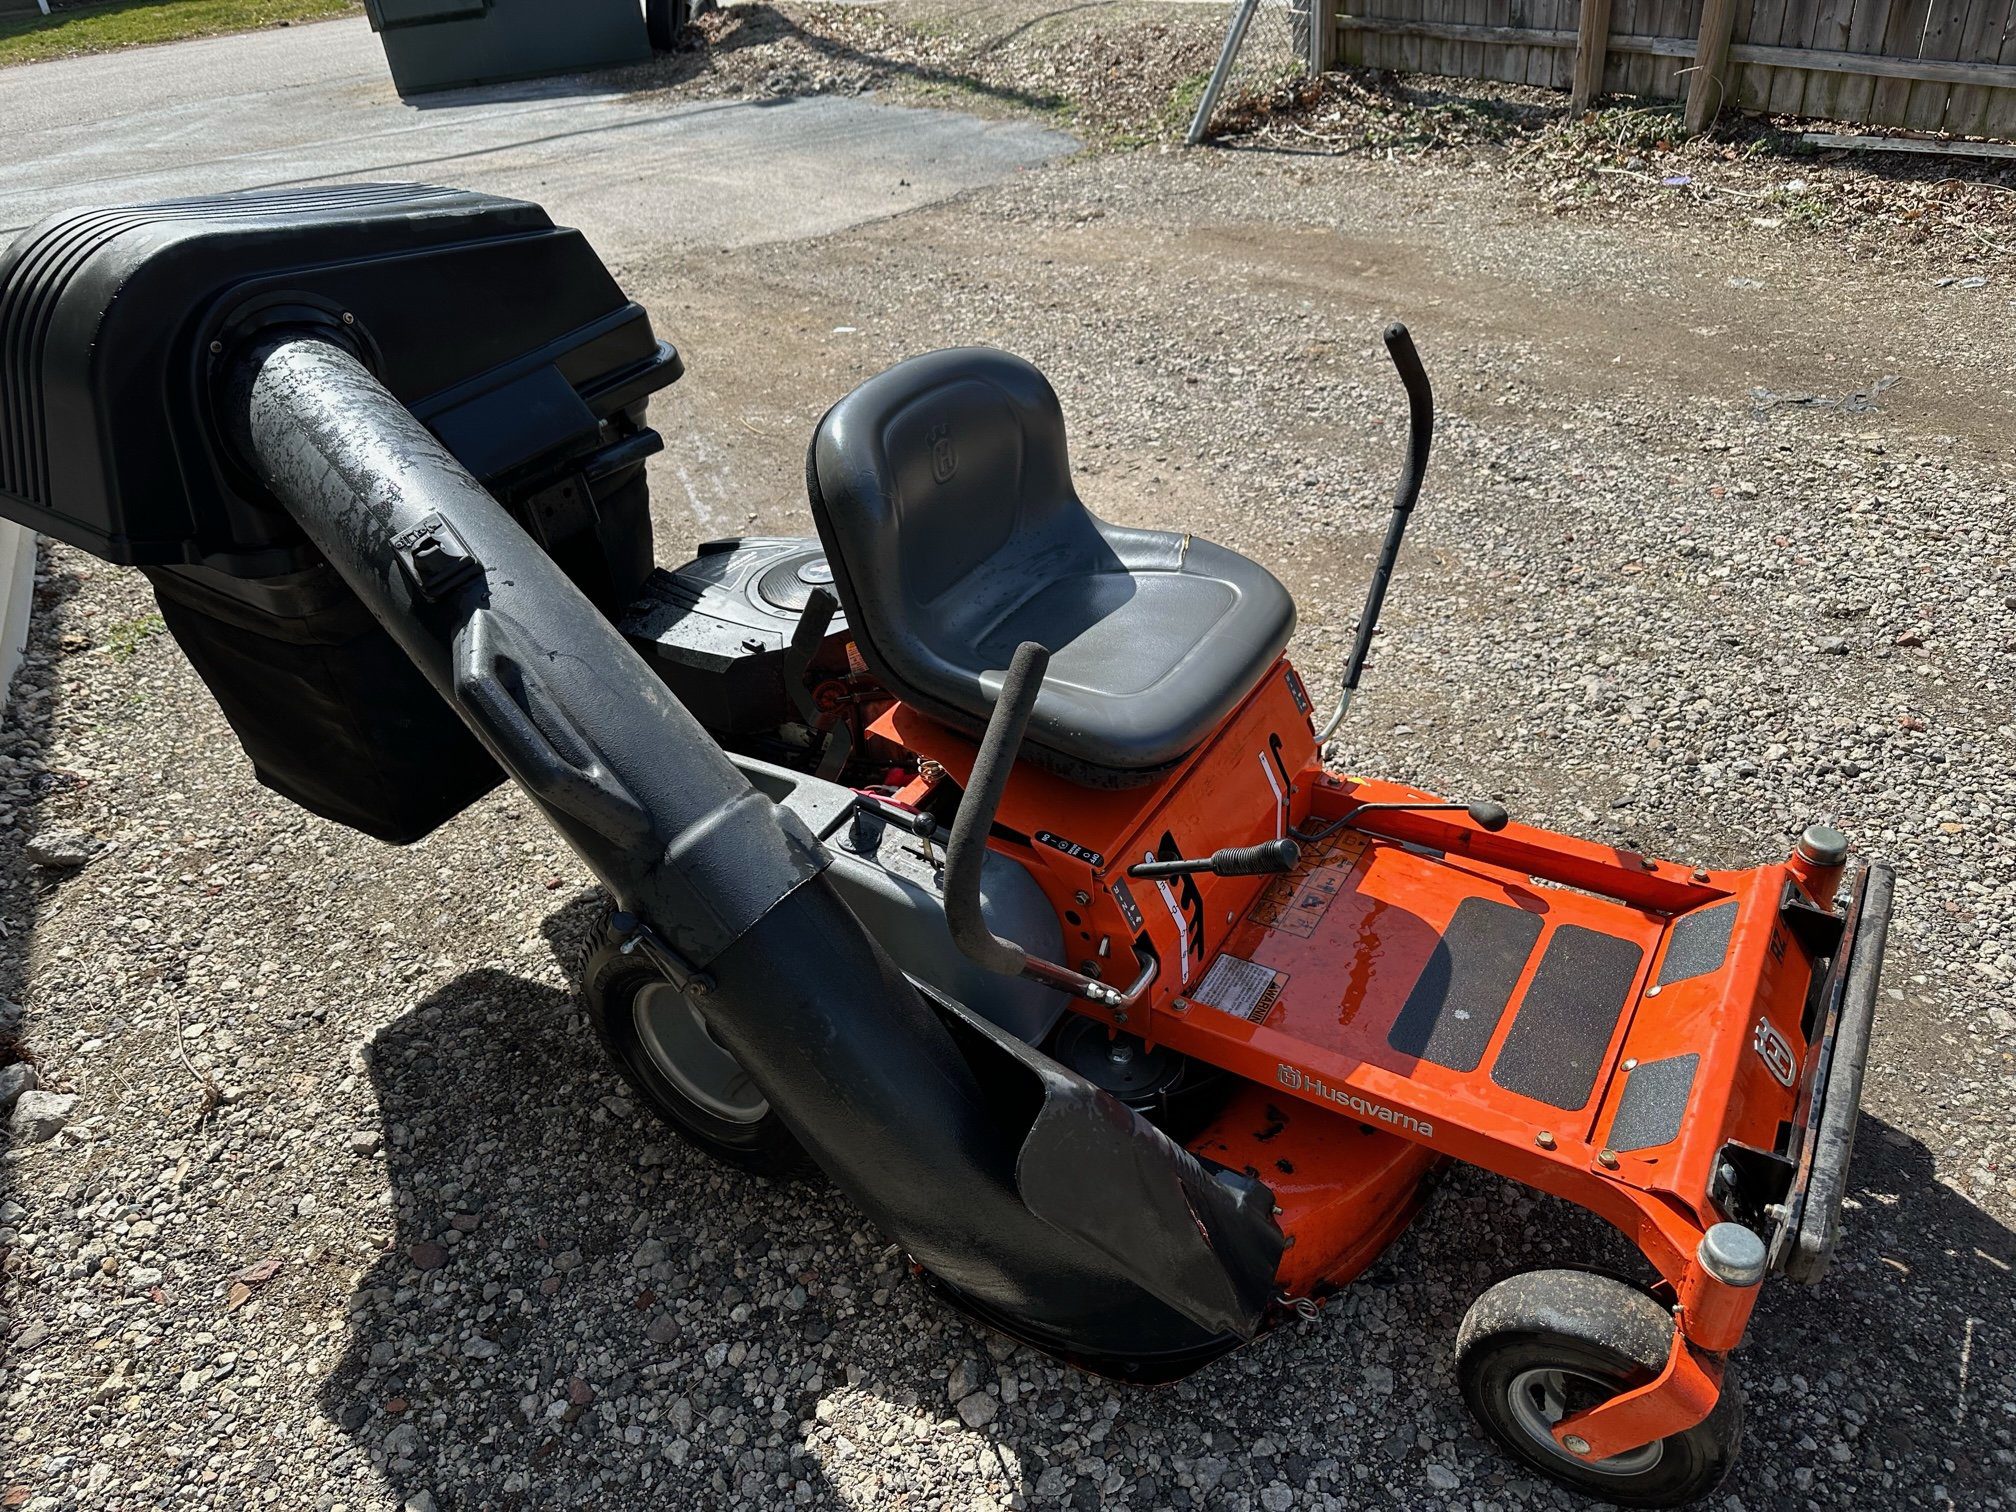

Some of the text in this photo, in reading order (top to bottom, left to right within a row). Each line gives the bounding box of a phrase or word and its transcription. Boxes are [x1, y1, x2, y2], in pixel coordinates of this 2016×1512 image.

[1089, 853, 1100, 864] OFF
[1113, 885, 1120, 894] R
[1250, 987, 1278, 1024] WARNIN
[1304, 1076, 1434, 1138] Husqvarna
